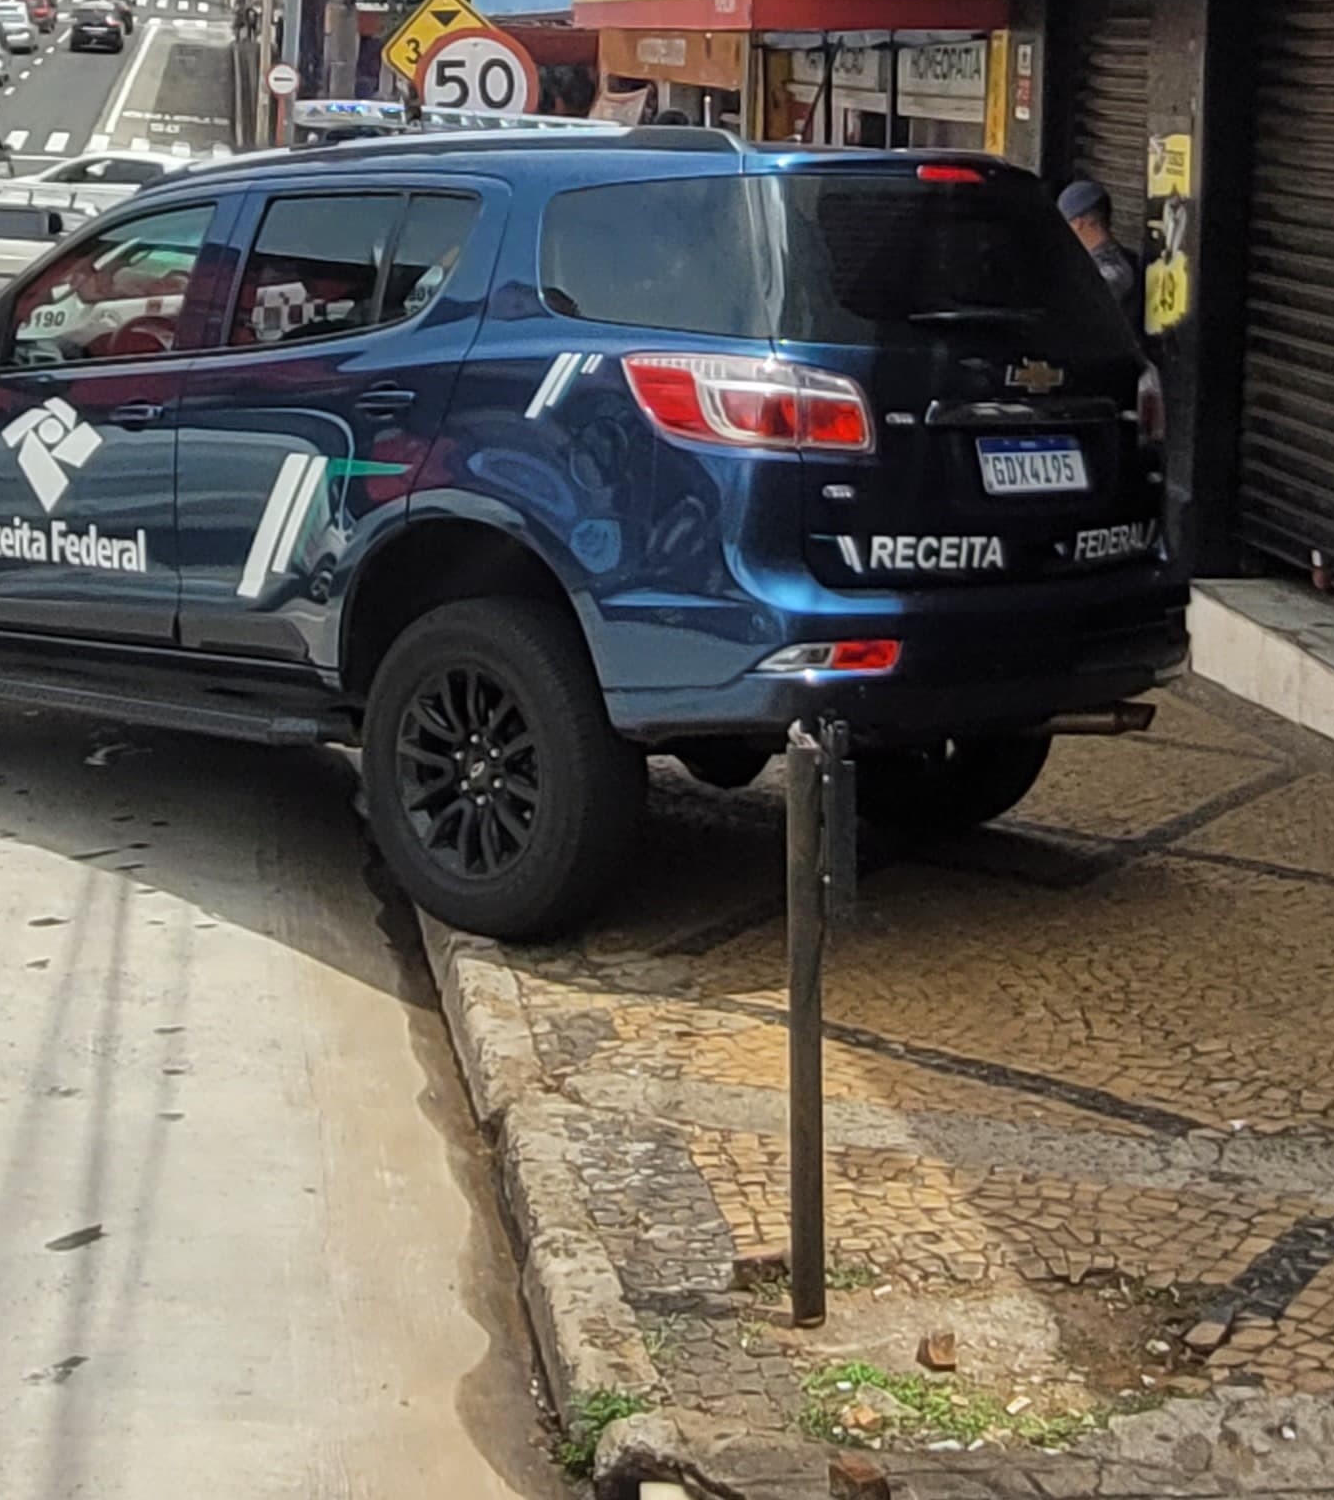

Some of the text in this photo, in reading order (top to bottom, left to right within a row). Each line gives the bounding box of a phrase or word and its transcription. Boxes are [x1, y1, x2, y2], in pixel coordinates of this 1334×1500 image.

[435, 57, 515, 109] 50
[34, 311, 66, 328] 190
[51, 520, 147, 573] Federal
[870, 522, 1148, 569] RECEITA FEDERAL
